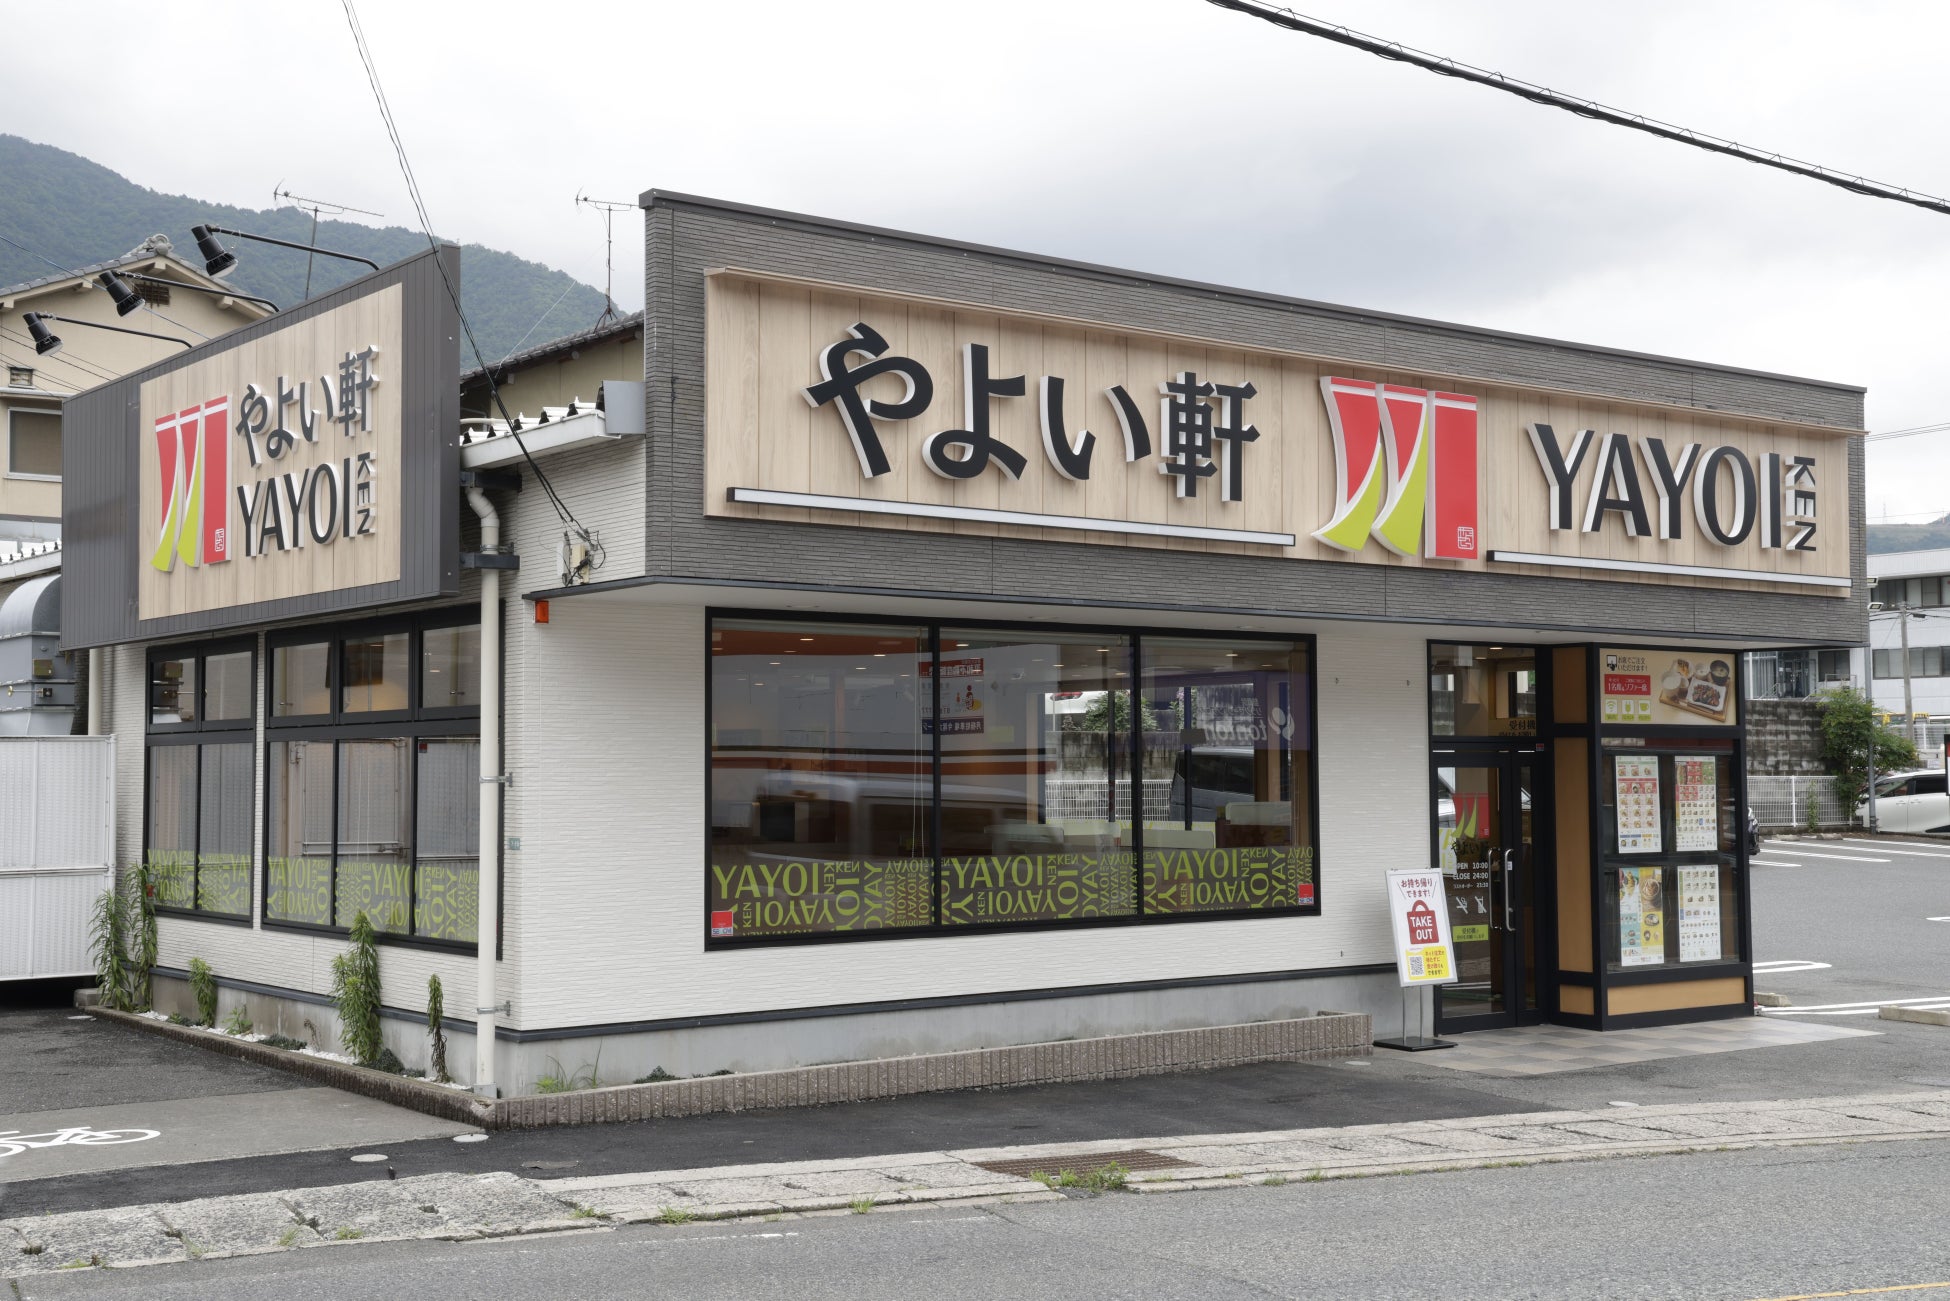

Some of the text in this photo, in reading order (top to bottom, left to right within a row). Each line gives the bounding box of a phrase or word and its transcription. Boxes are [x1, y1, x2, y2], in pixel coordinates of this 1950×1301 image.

[235, 344, 380, 469] やよい軒
[799, 321, 1261, 502] やよい軒
[356, 451, 377, 536] KEN
[1526, 422, 1782, 550] YAYOI
[237, 455, 356, 558] YAYOI
[1785, 455, 1816, 552] KEN
[268, 855, 311, 889] YAYOI
[823, 862, 835, 895] KEN
[951, 855, 1043, 889] YAYOI
[1047, 855, 1056, 885] KEN
[1157, 850, 1237, 881] YAYOI
[1241, 849, 1249, 878] KEN
[1456, 862, 1468, 870] PEN
[1472, 872, 1488, 880] 24:00
[711, 862, 820, 900] YAYOI
[1401, 878, 1433, 889] お持ち帰り
[1406, 889, 1431, 898] できます!
[1410, 915, 1433, 927] TAKE
[1415, 928, 1433, 940] OUT
